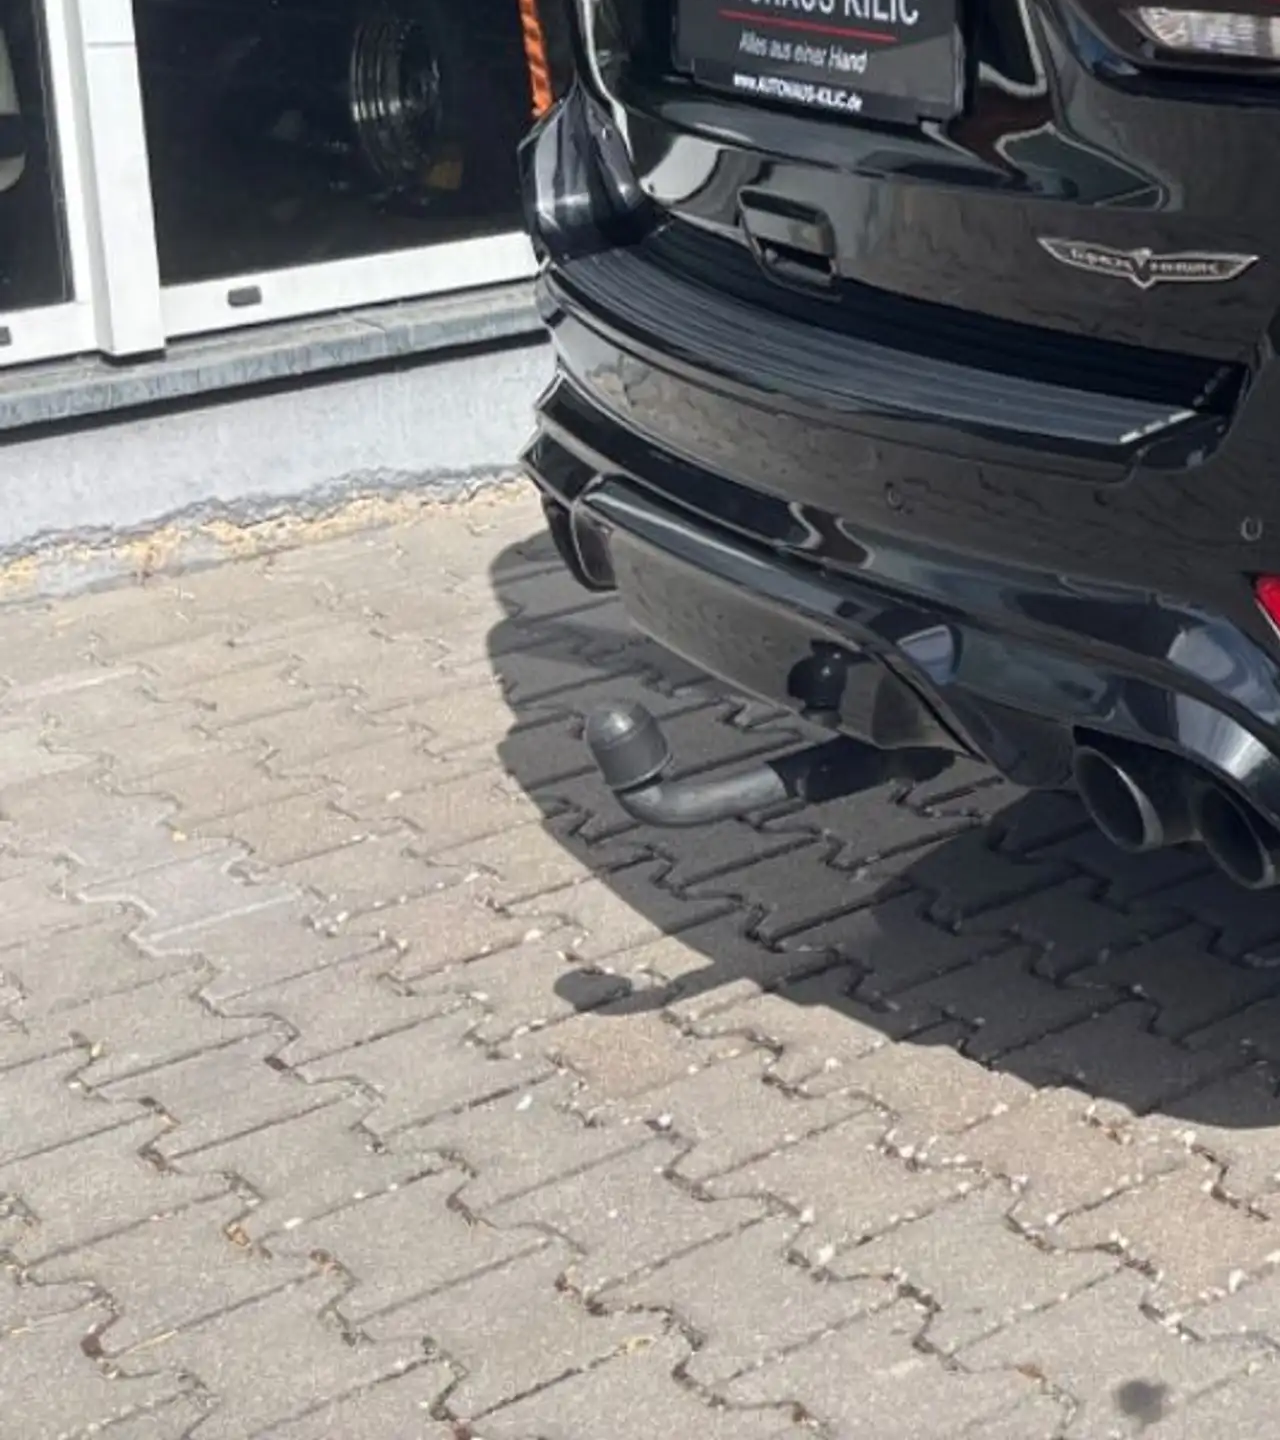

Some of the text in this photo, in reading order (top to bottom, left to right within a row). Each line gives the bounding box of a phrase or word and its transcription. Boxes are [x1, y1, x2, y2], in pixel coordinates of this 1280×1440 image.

[739, 29, 868, 73] Alles aus einer Hand
